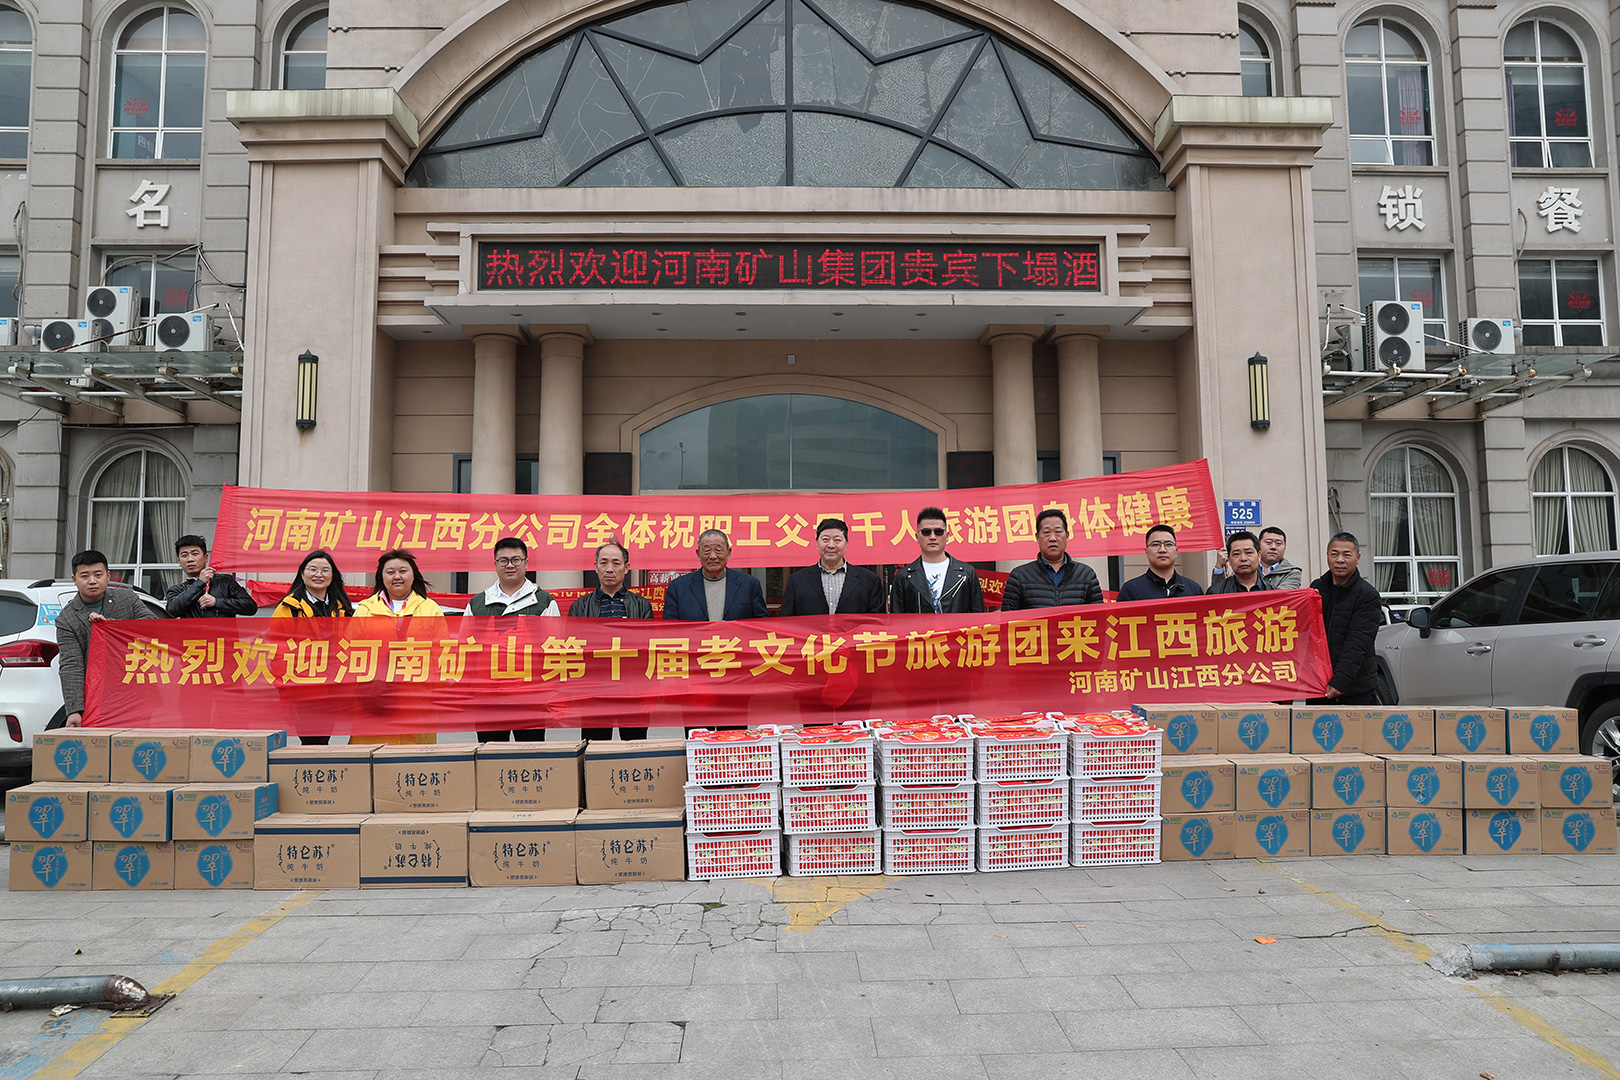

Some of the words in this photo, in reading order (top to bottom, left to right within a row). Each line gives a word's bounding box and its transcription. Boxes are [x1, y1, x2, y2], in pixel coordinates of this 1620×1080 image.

[126, 180, 170, 229] 名
[1379, 185, 1426, 231] 锁
[1538, 186, 1584, 234] 餐
[485, 248, 1098, 287] 热烈欢迎河南矿山集团贵宾下塌酒
[243, 486, 1194, 551] 河南矿山江西分公司全体祝职工父千人旅游团体健康
[1232, 508, 1253, 520] 525
[122, 605, 1299, 686] 热烈欢迎河南矿山第十届孝文化节旅游团来江西旅游
[1068, 661, 1298, 694] 河南矿山江西分公司
[302, 769, 338, 783] 特仑苏
[405, 772, 440, 786] 特仑苏
[508, 768, 542, 783] 特仑苏
[618, 768, 654, 783] 特仑苏
[286, 845, 323, 860] 特仑苏
[502, 843, 540, 858] 特仑苏
[610, 840, 647, 854] 特仑苏
[395, 854, 432, 868] 特仑苏
